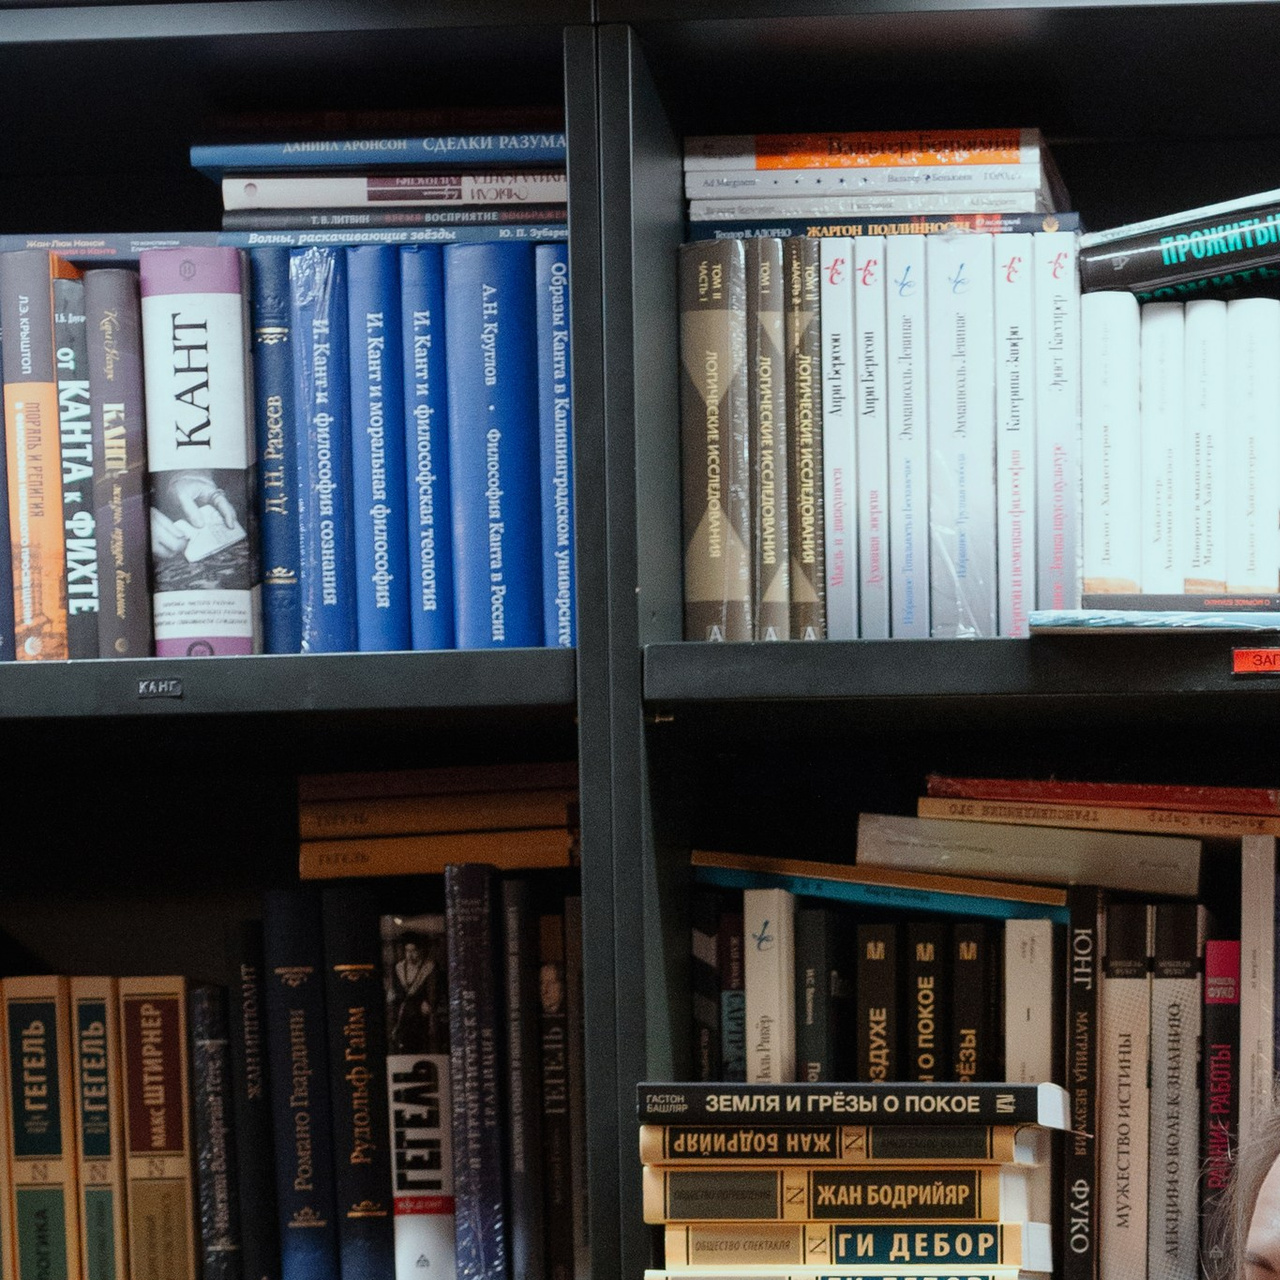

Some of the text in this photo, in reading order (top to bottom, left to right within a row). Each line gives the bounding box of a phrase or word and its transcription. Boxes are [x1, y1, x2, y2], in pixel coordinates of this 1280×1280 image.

[283, 139, 407, 153] ДАНИИЛ АРОНСОН
[423, 135, 567, 153] СДЕЛКИ РАЗУМА
[248, 229, 456, 245] Волны, раскачивающие звёзды
[807, 225, 862, 238] ЖАРГОН
[868, 221, 970, 235] ПОДЛИННОСТИ
[21, 319, 32, 374] КРЫШТОП
[366, 313, 383, 334] И.
[481, 285, 498, 386] А.Н. Круглов
[172, 313, 211, 449] КАНТ
[368, 342, 385, 382] Кант
[58, 380, 94, 485] КАНТА
[368, 402, 386, 500] моральная
[486, 429, 501, 517] Философия
[65, 510, 99, 616] ФИХТЕ
[370, 503, 394, 608] философия
[489, 523, 505, 569] Канта
[489, 584, 506, 641] России
[1073, 928, 1092, 991] ЮНГ
[22, 1020, 48, 1112] ГЕГЕЛЬ
[140, 1002, 165, 1106] ШТИРНЕР
[344, 1006, 372, 1166] Рудольф Гайм
[646, 1094, 685, 1104] ГАСТОН
[646, 1103, 689, 1113] БАШЛЯР
[705, 1090, 981, 1113] ЗЕМЛЯ И ГРЁЗЫ О ПОКОЕ
[391, 1060, 444, 1192] ГЕГЕЛЬ
[1117, 1033, 1131, 1228] МУЖЕСТВО ИСТИНЫ
[817, 1183, 970, 1208] ЖАН БОДРИЙЯР
[1070, 1179, 1090, 1254] ФУКО
[695, 1239, 791, 1253] ОБЩЕСТВО СПЕКТАКЛЯ
[838, 1233, 995, 1261] ГИ ДЕБОР
